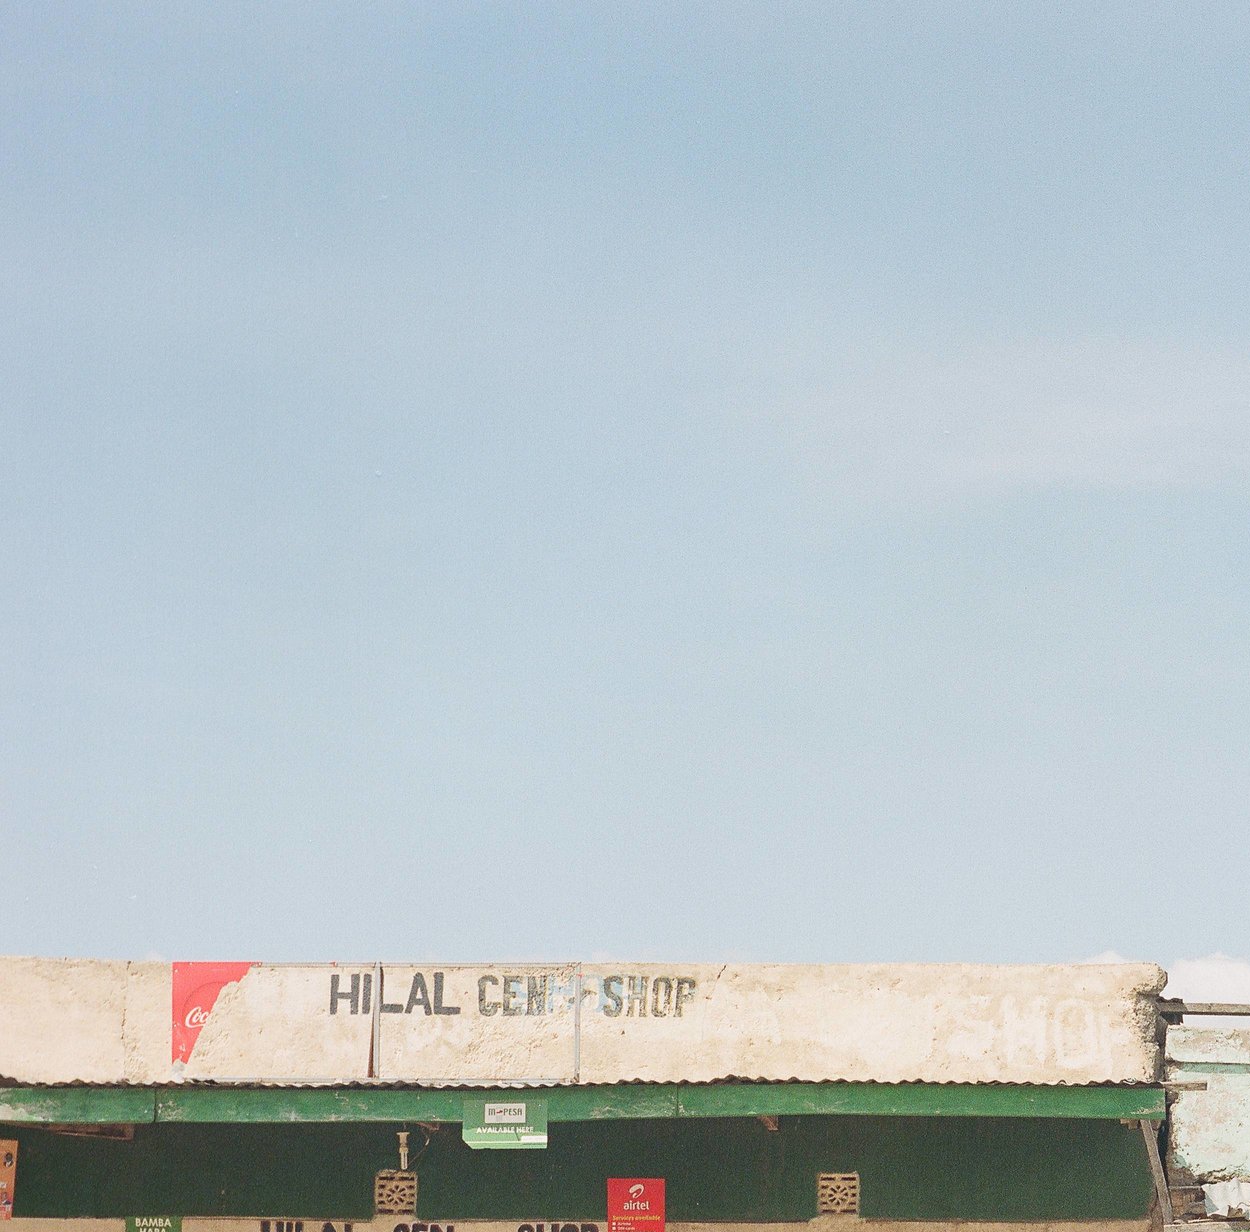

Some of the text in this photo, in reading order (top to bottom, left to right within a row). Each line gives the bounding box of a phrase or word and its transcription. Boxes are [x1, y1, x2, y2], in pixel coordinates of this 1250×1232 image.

[330, 971, 462, 1016] HILAL
[603, 974, 697, 1018] SHOP
[476, 1126, 534, 1134] AVAILABLE HERE
[623, 1200, 650, 1211] airtel
[135, 1217, 172, 1228] BAMBA
